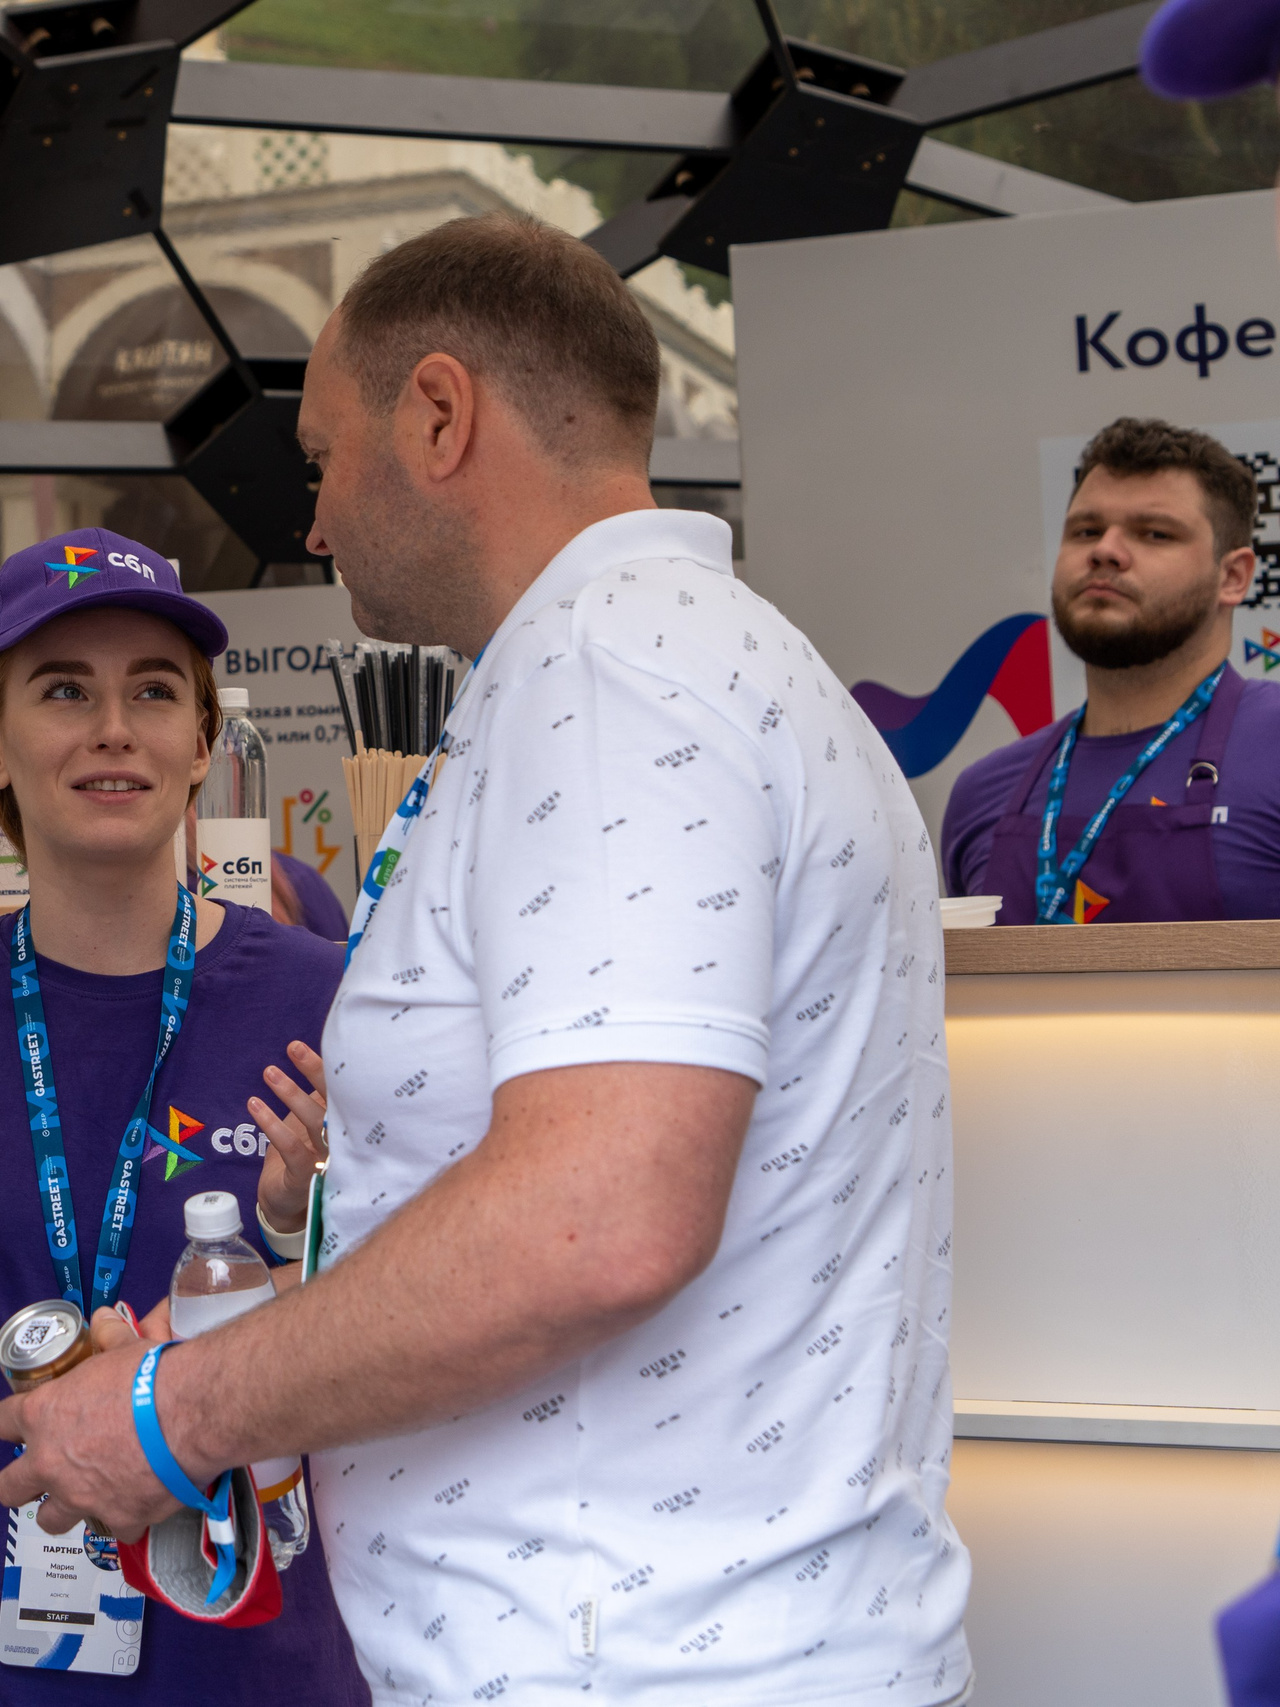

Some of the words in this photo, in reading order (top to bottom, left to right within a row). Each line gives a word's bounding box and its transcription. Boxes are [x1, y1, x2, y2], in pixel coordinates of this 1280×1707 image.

[1075, 304, 1276, 379] Кофе
[107, 552, 156, 584] сбп
[654, 743, 700, 767] GUESS
[222, 857, 262, 875] сбп
[696, 887, 740, 910] GUESS
[179, 894, 190, 948] GASTREET
[392, 965, 426, 982] GUESS
[796, 992, 836, 1021] GUESS
[27, 1033, 45, 1097] GASTREET
[394, 1069, 428, 1098] GUESS
[760, 1143, 809, 1173] GUESS
[111, 1160, 133, 1231] GASTREET
[48, 1177, 67, 1248] GASTREET
[806, 1324, 844, 1357] GUESS
[639, 1349, 687, 1378] GUESS
[522, 1393, 566, 1422] GUESS
[746, 1420, 786, 1453] GUESS
[434, 1478, 471, 1504] GUESS
[653, 1486, 701, 1513] GUESS
[43, 1545, 83, 1555] ПАРТНЕР
[45, 1572, 77, 1580] Матаева
[50, 1563, 75, 1572] Мария
[611, 1564, 655, 1592] GUESS
[795, 1549, 831, 1582] GUESS
[46, 1613, 70, 1622] STAFF
[4, 1644, 40, 1655] PARTNER
[680, 1622, 724, 1654] GUESS
[473, 1673, 510, 1700] GUESS
